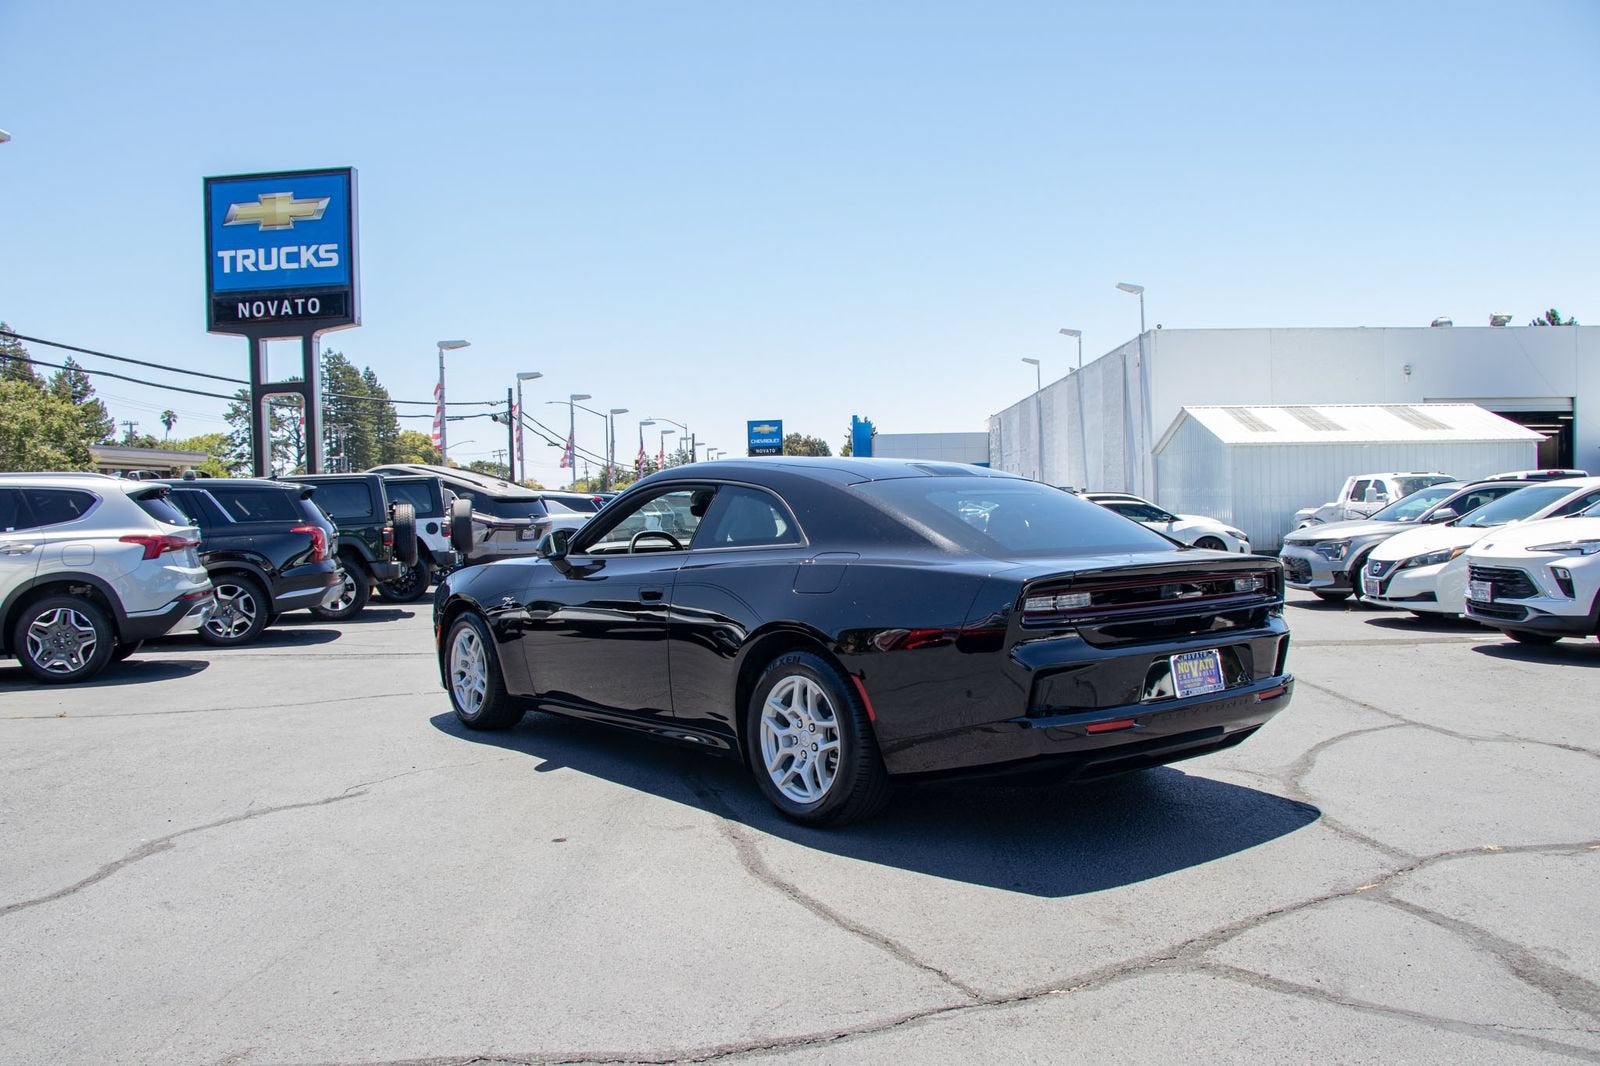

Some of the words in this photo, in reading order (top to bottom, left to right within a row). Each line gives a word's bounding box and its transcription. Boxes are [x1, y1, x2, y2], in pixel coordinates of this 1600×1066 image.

[218, 243, 339, 273] TRUCKS
[238, 297, 320, 318] NOVATO
[1177, 658, 1214, 677] NOVATO
